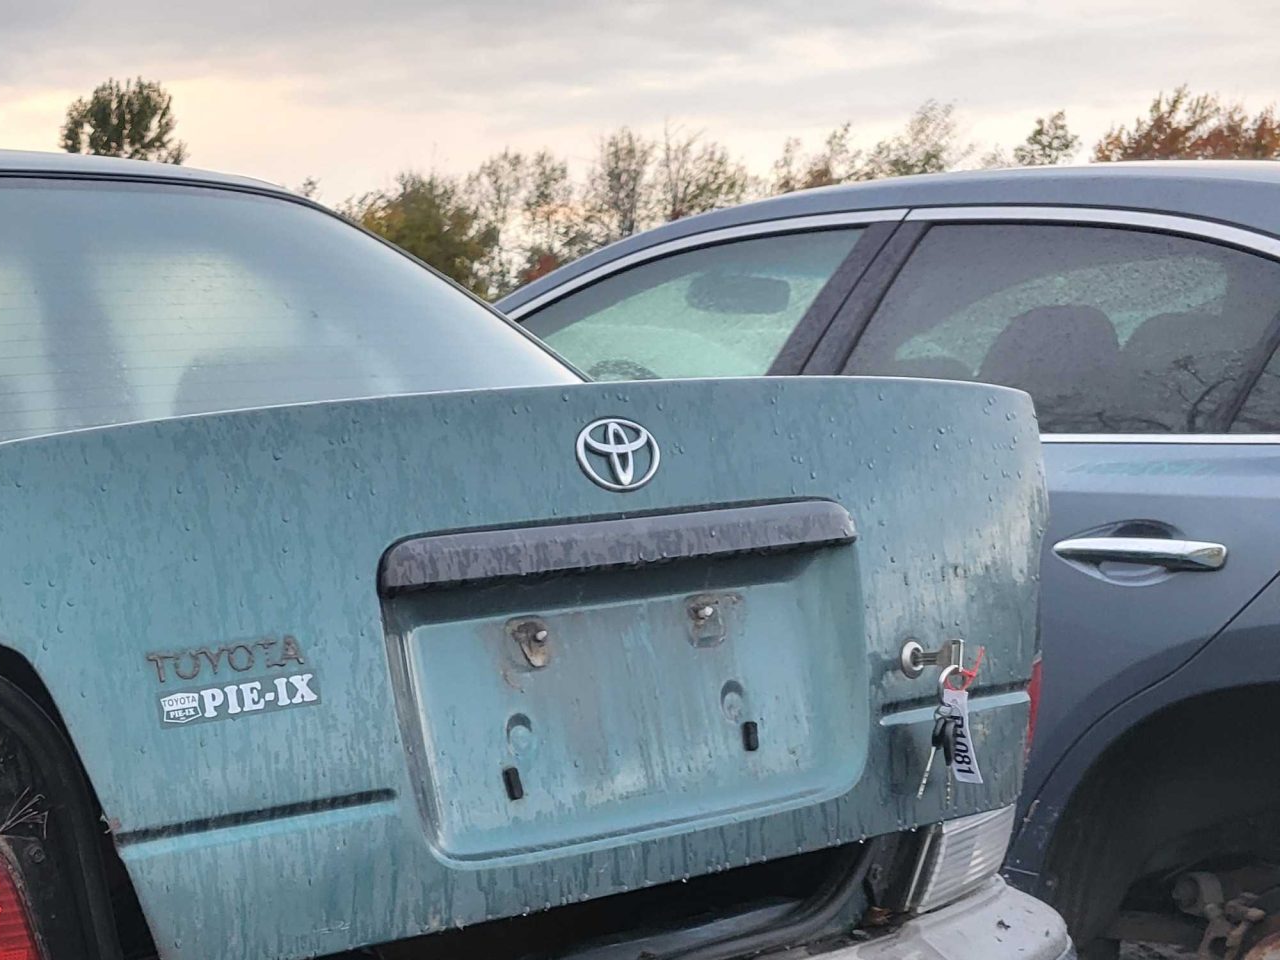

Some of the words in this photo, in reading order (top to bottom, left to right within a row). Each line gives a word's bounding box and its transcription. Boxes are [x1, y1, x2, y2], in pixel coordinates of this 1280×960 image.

[145, 634, 305, 684] TOYOTA
[162, 696, 196, 708] TOYOTA
[200, 673, 318, 719] PIE-IX
